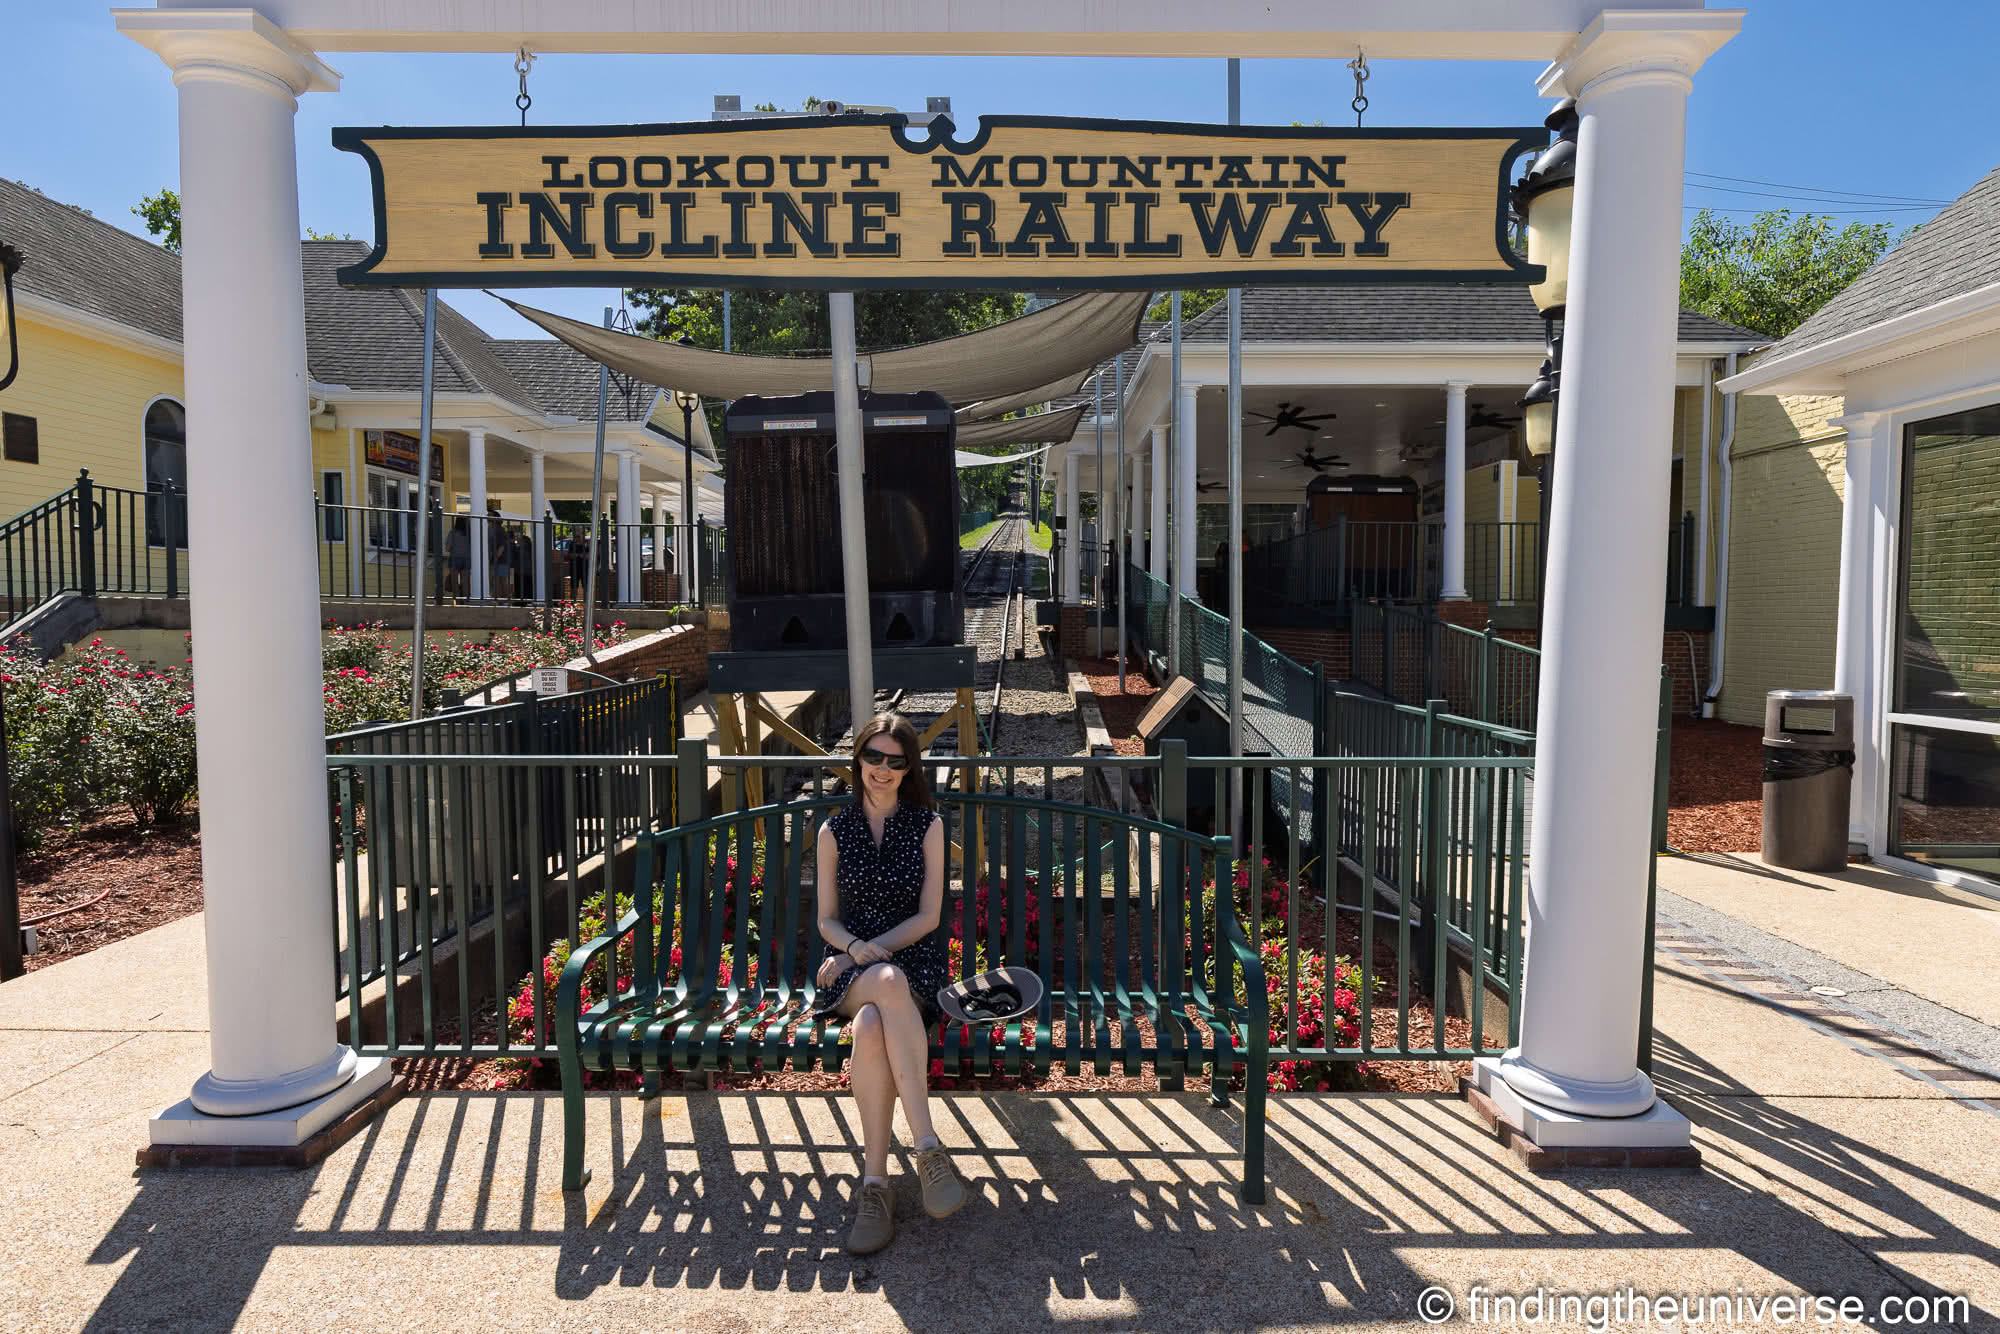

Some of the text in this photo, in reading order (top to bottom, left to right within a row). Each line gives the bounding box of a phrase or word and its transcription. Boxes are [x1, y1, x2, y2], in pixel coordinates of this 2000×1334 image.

[542, 155, 1346, 188] LOOKOUT MOUNTAIN
[477, 192, 1411, 259] INCLINE RAILWAY
